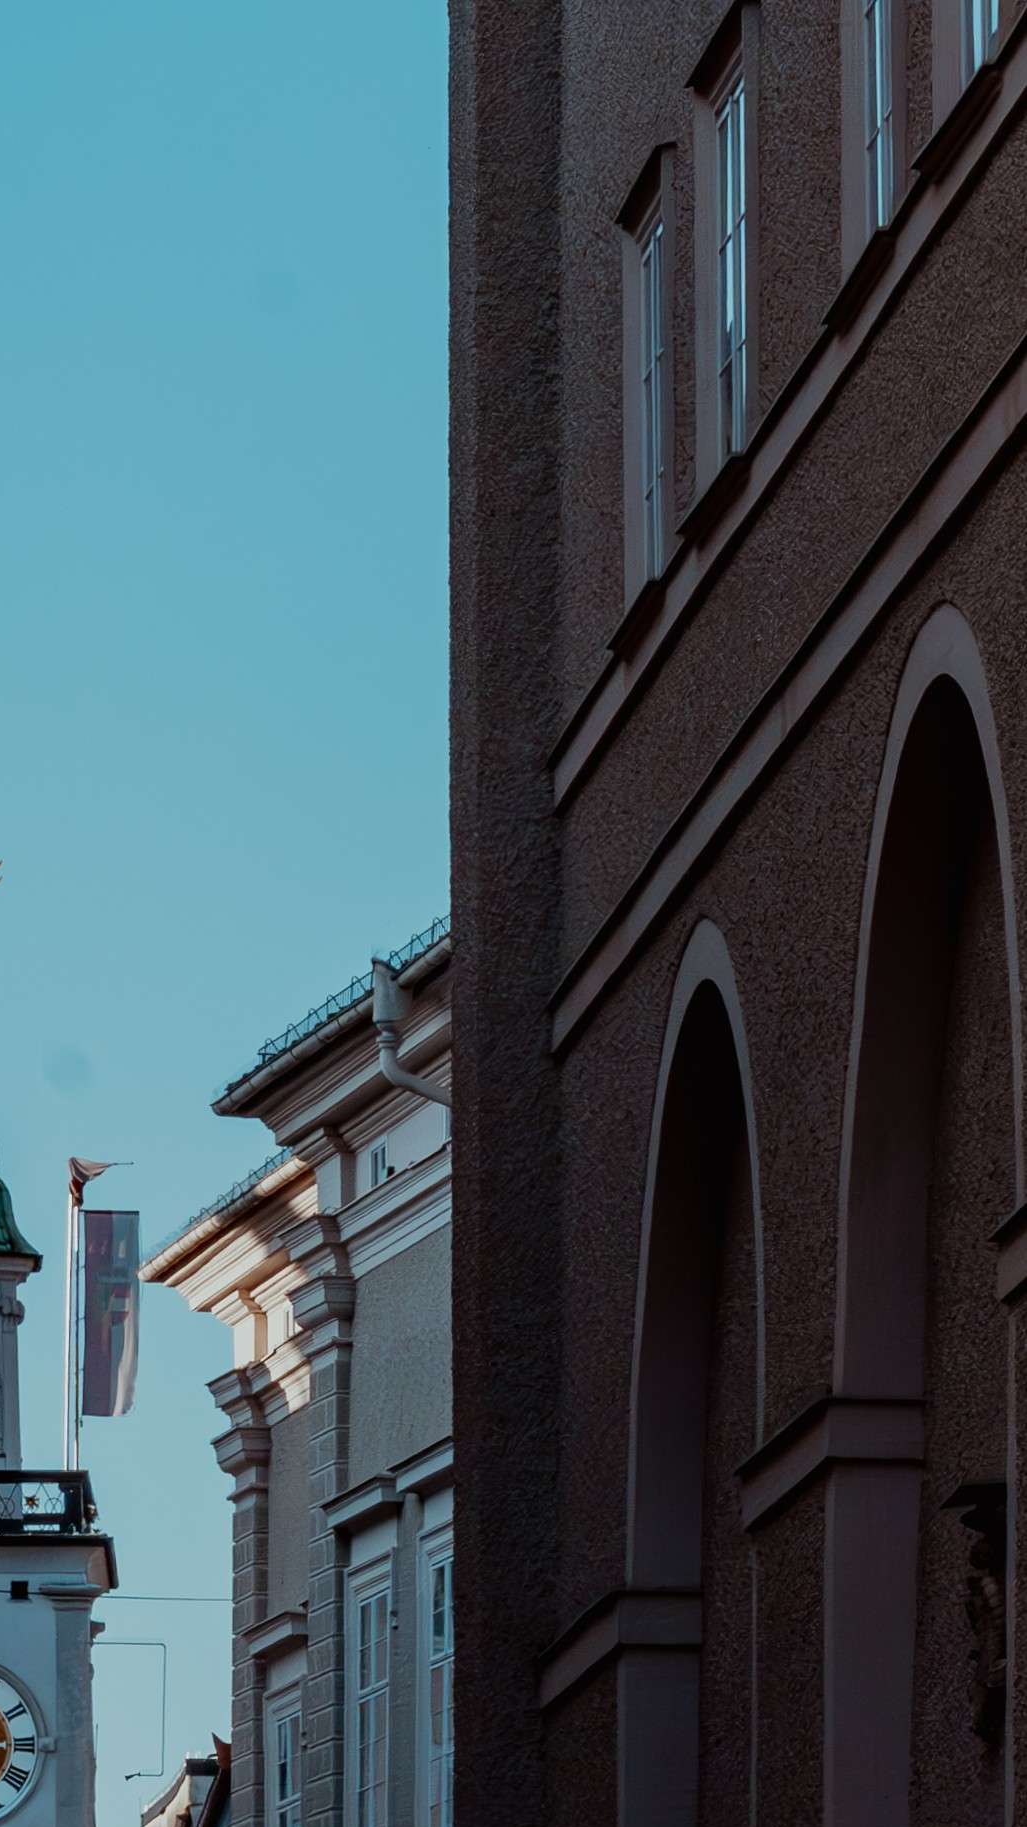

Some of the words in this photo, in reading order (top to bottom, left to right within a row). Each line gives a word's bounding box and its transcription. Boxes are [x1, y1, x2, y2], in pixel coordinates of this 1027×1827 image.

[3, 1701, 27, 1722] II
[13, 1735, 35, 1754] III
[2, 1764, 30, 1793] IIII
